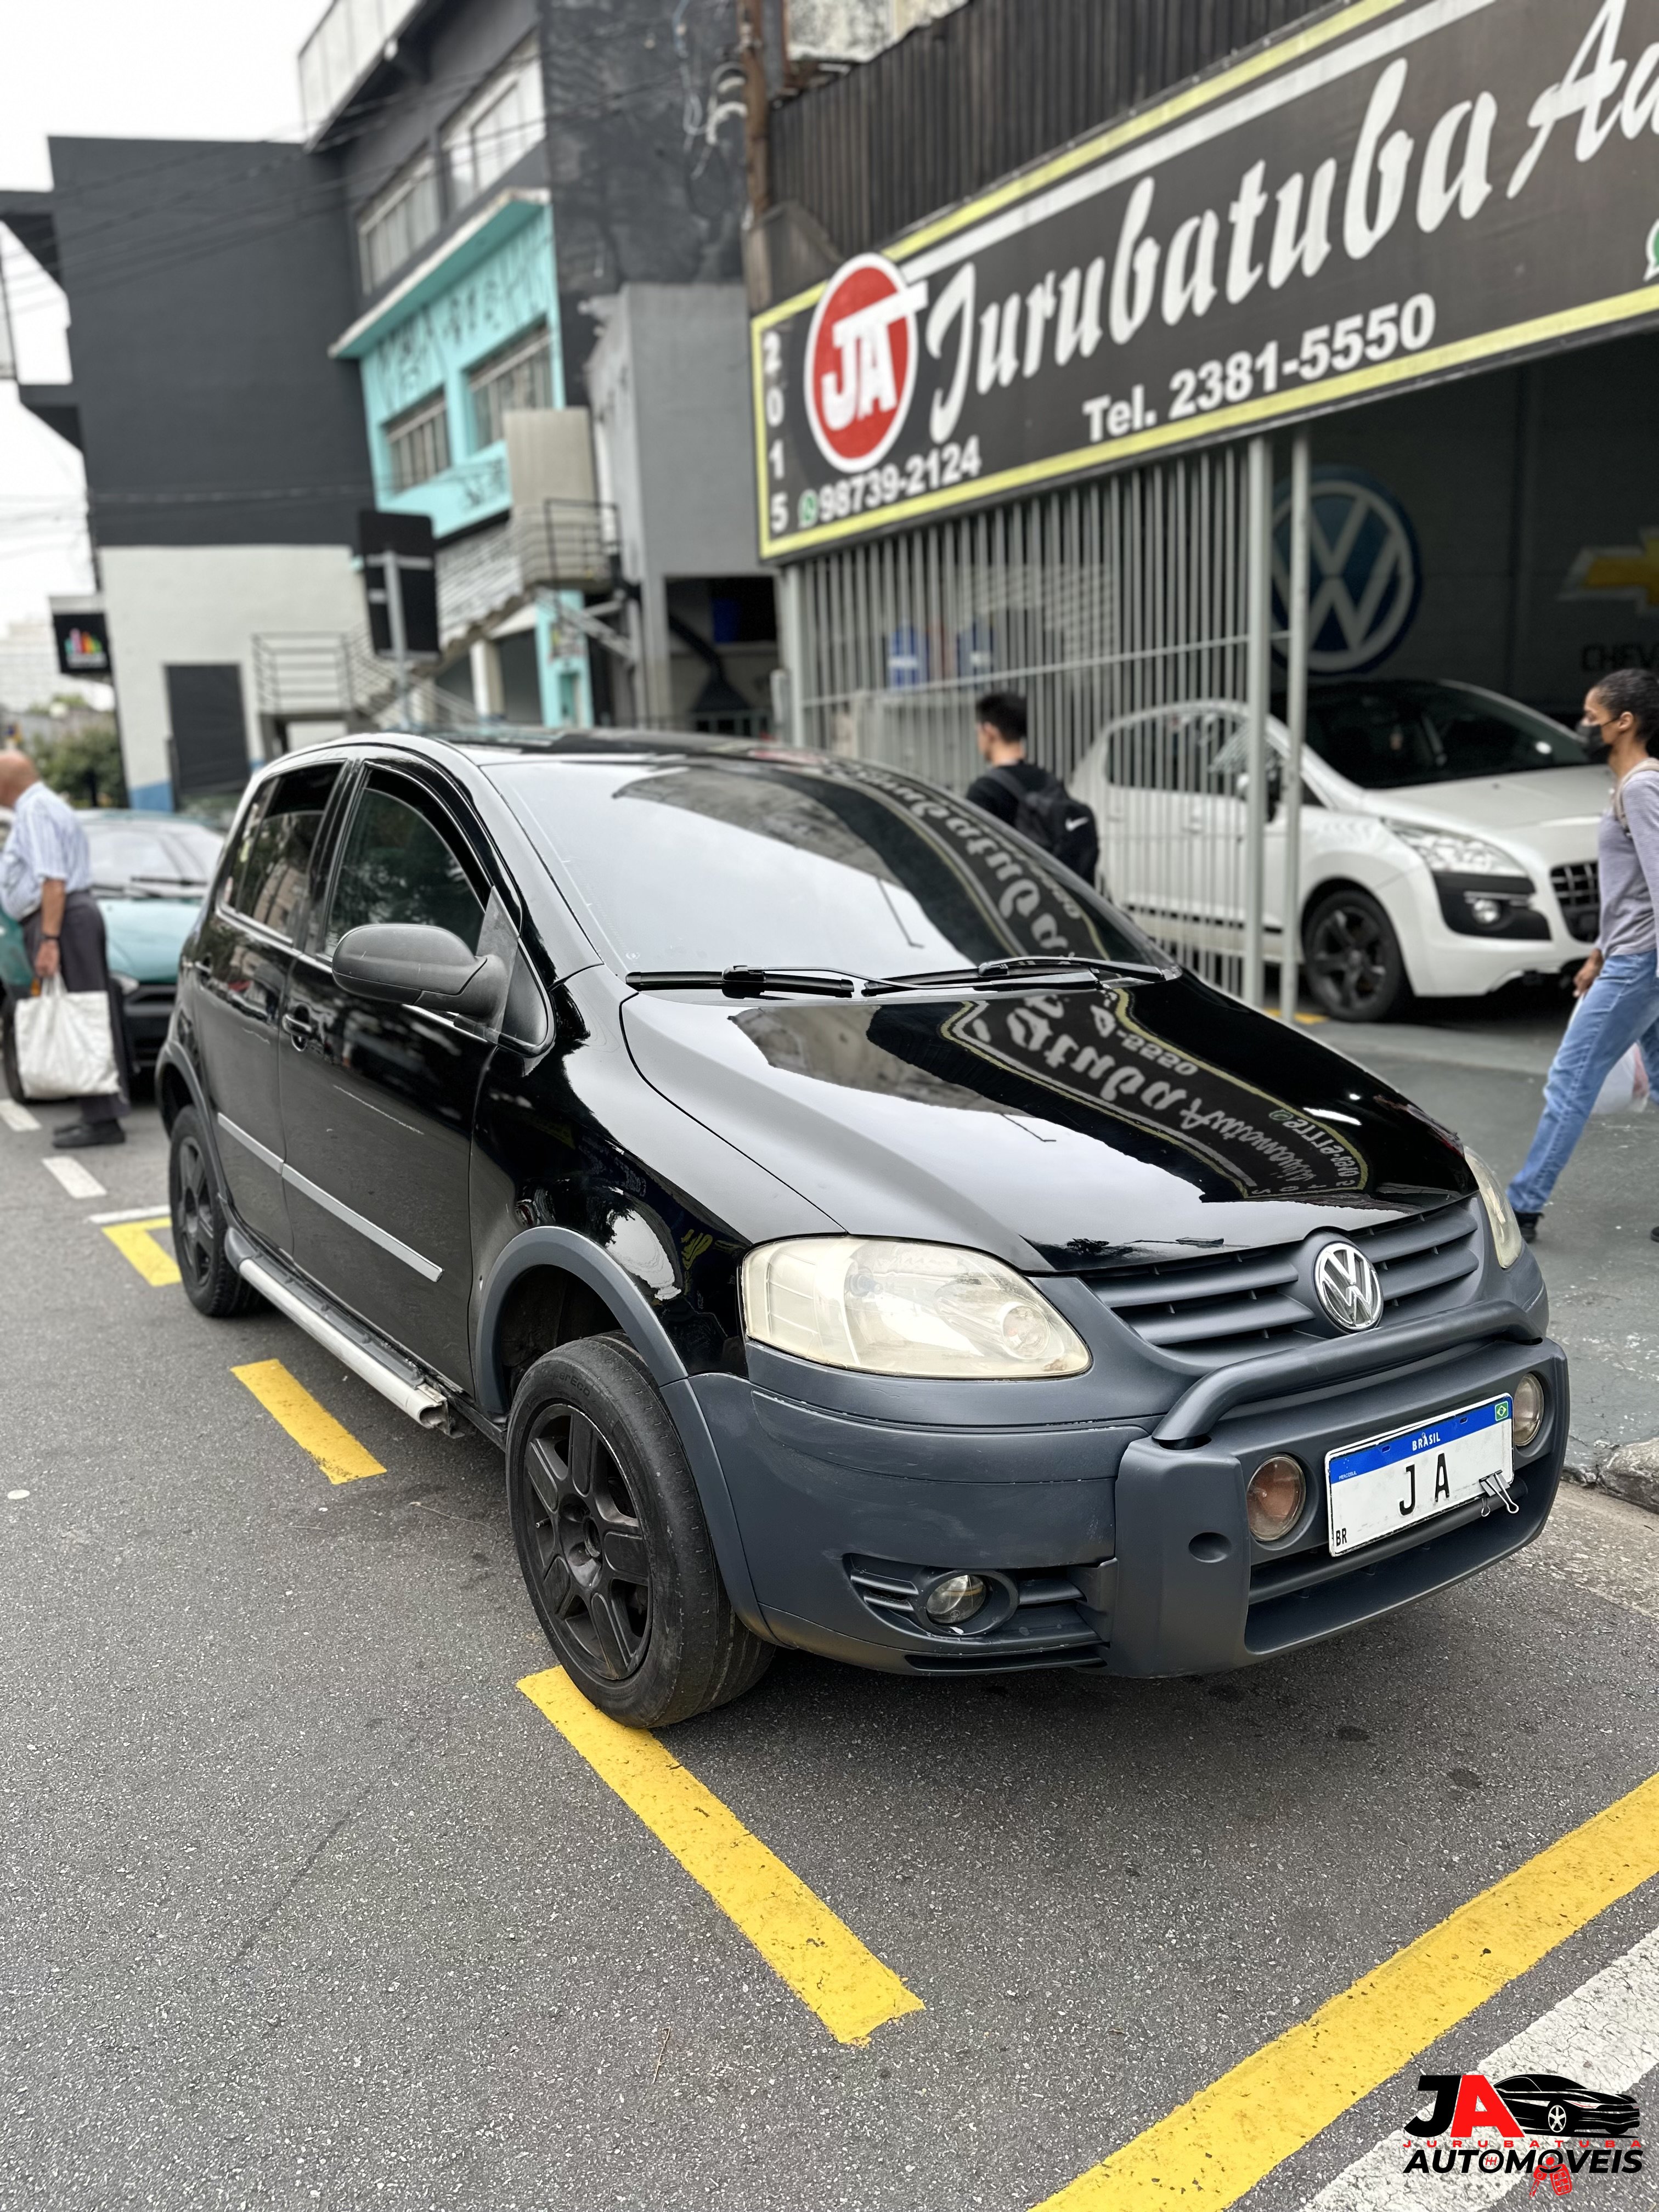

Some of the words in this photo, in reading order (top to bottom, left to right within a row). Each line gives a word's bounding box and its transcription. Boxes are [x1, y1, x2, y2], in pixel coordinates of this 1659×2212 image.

[925, 57, 1498, 443] Jurubatuba
[1082, 384, 1156, 442] Tel.
[1169, 292, 1435, 420] 2381-5550
[763, 330, 789, 533] 2015
[819, 435, 981, 522] 98739-2124
[1399, 1464, 1415, 1516] J
[1435, 1452, 1450, 1502] A
[1412, 1432, 1441, 1451] BRASIL
[1335, 1527, 1348, 1547] BR
